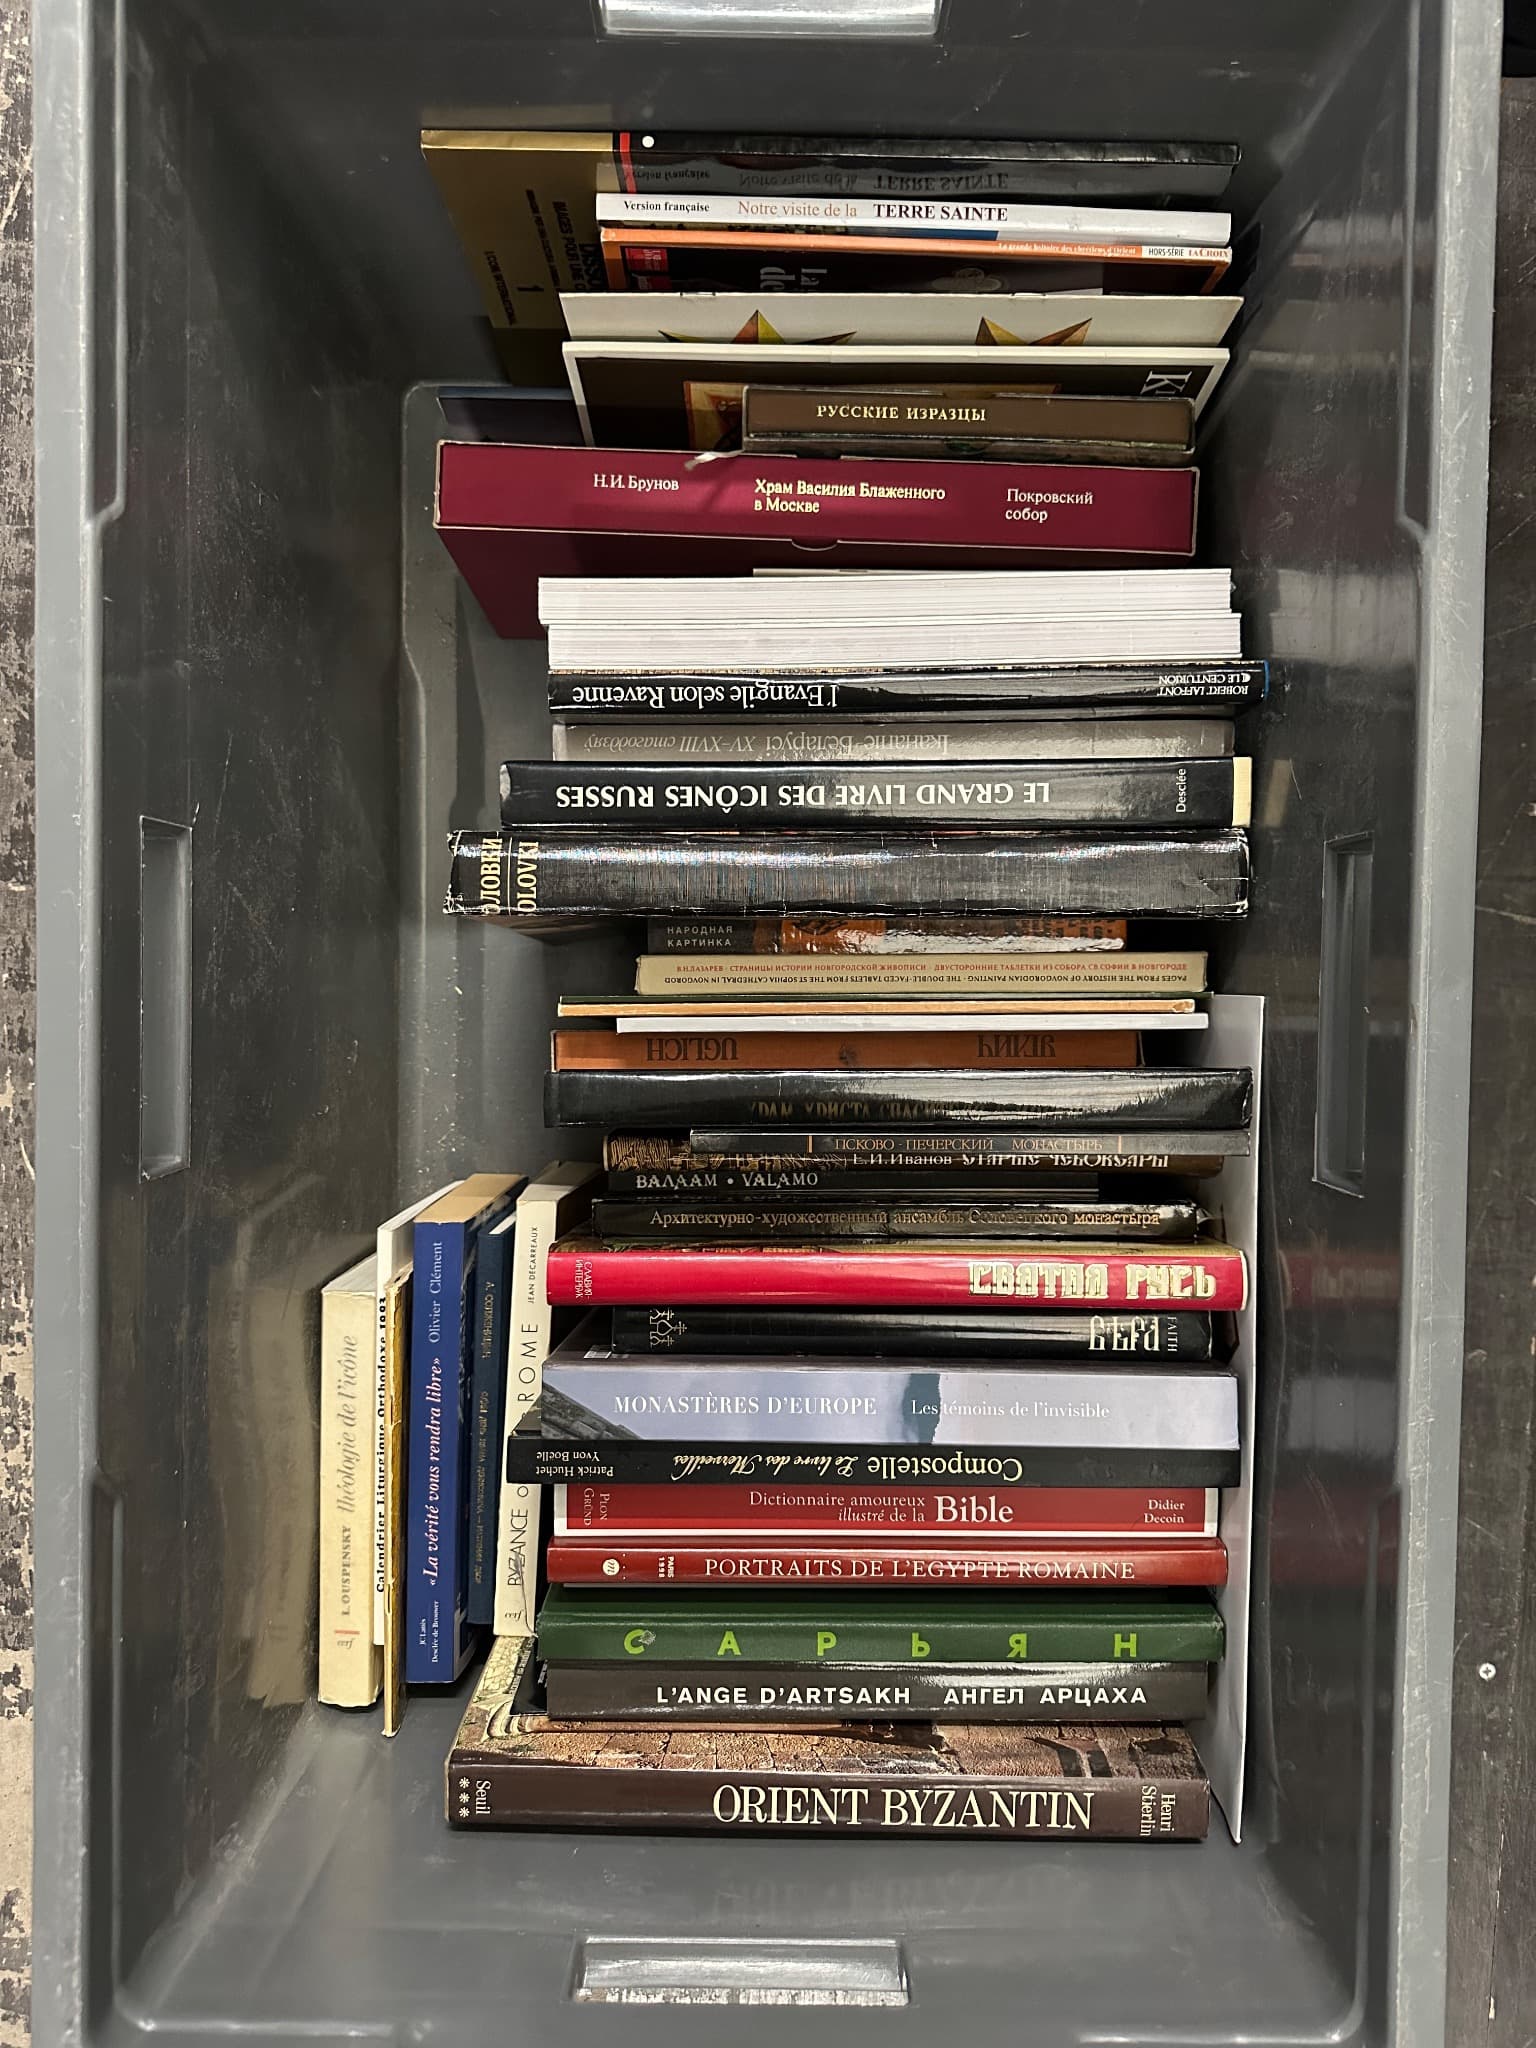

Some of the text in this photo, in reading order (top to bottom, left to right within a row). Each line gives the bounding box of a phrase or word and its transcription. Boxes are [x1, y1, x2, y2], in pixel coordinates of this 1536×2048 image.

[624, 201, 710, 214] Version française
[738, 200, 1009, 222] Notre visite de la TERRE SAINTE
[1149, 247, 1184, 257] HORS-SÉRIE
[817, 405, 986, 422] РУССКИЕ ИЗРАЗЦЫ
[628, 475, 679, 491] Брунов
[755, 479, 945, 501] Храм Василия Блаженного
[754, 498, 820, 513] в Москве
[1007, 488, 1093, 506] Покровский
[1005, 507, 1048, 522] собор
[1159, 673, 1241, 684] LE CENTURION
[572, 685, 665, 709] Ravenne
[670, 686, 726, 708] selon
[1157, 685, 1249, 696] ROBERT LAFFONT
[555, 782, 1050, 814] LE GRAND LIVRE DES ICÔNES RUSSES
[1175, 768, 1188, 813] Desclée
[517, 841, 539, 914] OLOVKI
[667, 925, 733, 936] НАРОДНАЯ
[667, 937, 732, 948] КАРТИНКА
[645, 1037, 739, 1061] UGLICH
[834, 1138, 1103, 1151] ПСКОВО ПЕЧЕРСКИЙ МОНАСТЫРЬ
[636, 1173, 718, 1190] ВАЛААМ
[742, 1171, 819, 1189] VALAMO
[968, 1261, 1217, 1300] СВЯТАЯ РУСЬ
[428, 1241, 442, 1343] Olivier Clément
[1167, 1316, 1178, 1352] FAITH
[518, 1323, 539, 1402] ROME
[613, 1391, 1111, 1419] MONASTÈRES D'EUROPE Les témoins de l'invisible
[337, 1336, 360, 1513] théologie de l'icône
[425, 1402, 441, 1458] rendra
[573, 1451, 600, 1462] Yvon
[867, 1451, 1024, 1482] Compostelle
[535, 1465, 614, 1477] Patrick Huchet
[428, 1464, 440, 1501] vous
[749, 1491, 925, 1508] Dictionnaire amoureux
[838, 1495, 1014, 1524] illustré de la Bible
[1148, 1499, 1185, 1511] Didier
[425, 1505, 440, 1548] vérité
[1143, 1513, 1185, 1524] Decoin
[508, 1508, 529, 1586] BYZANCE
[705, 1559, 1135, 1579] PORTRAITS DE L'EGYPTE ROMAINE
[656, 1687, 911, 1704] L'ANGE D'ARTSAKH
[944, 1687, 1147, 1707] АНГЕЛ АРЦАХА
[475, 1780, 492, 1815] Seuil
[712, 1784, 1095, 1830] ORIENT BYZANTIN
[1140, 1785, 1157, 1837] Stierlin
[1160, 1793, 1176, 1832] Henri
